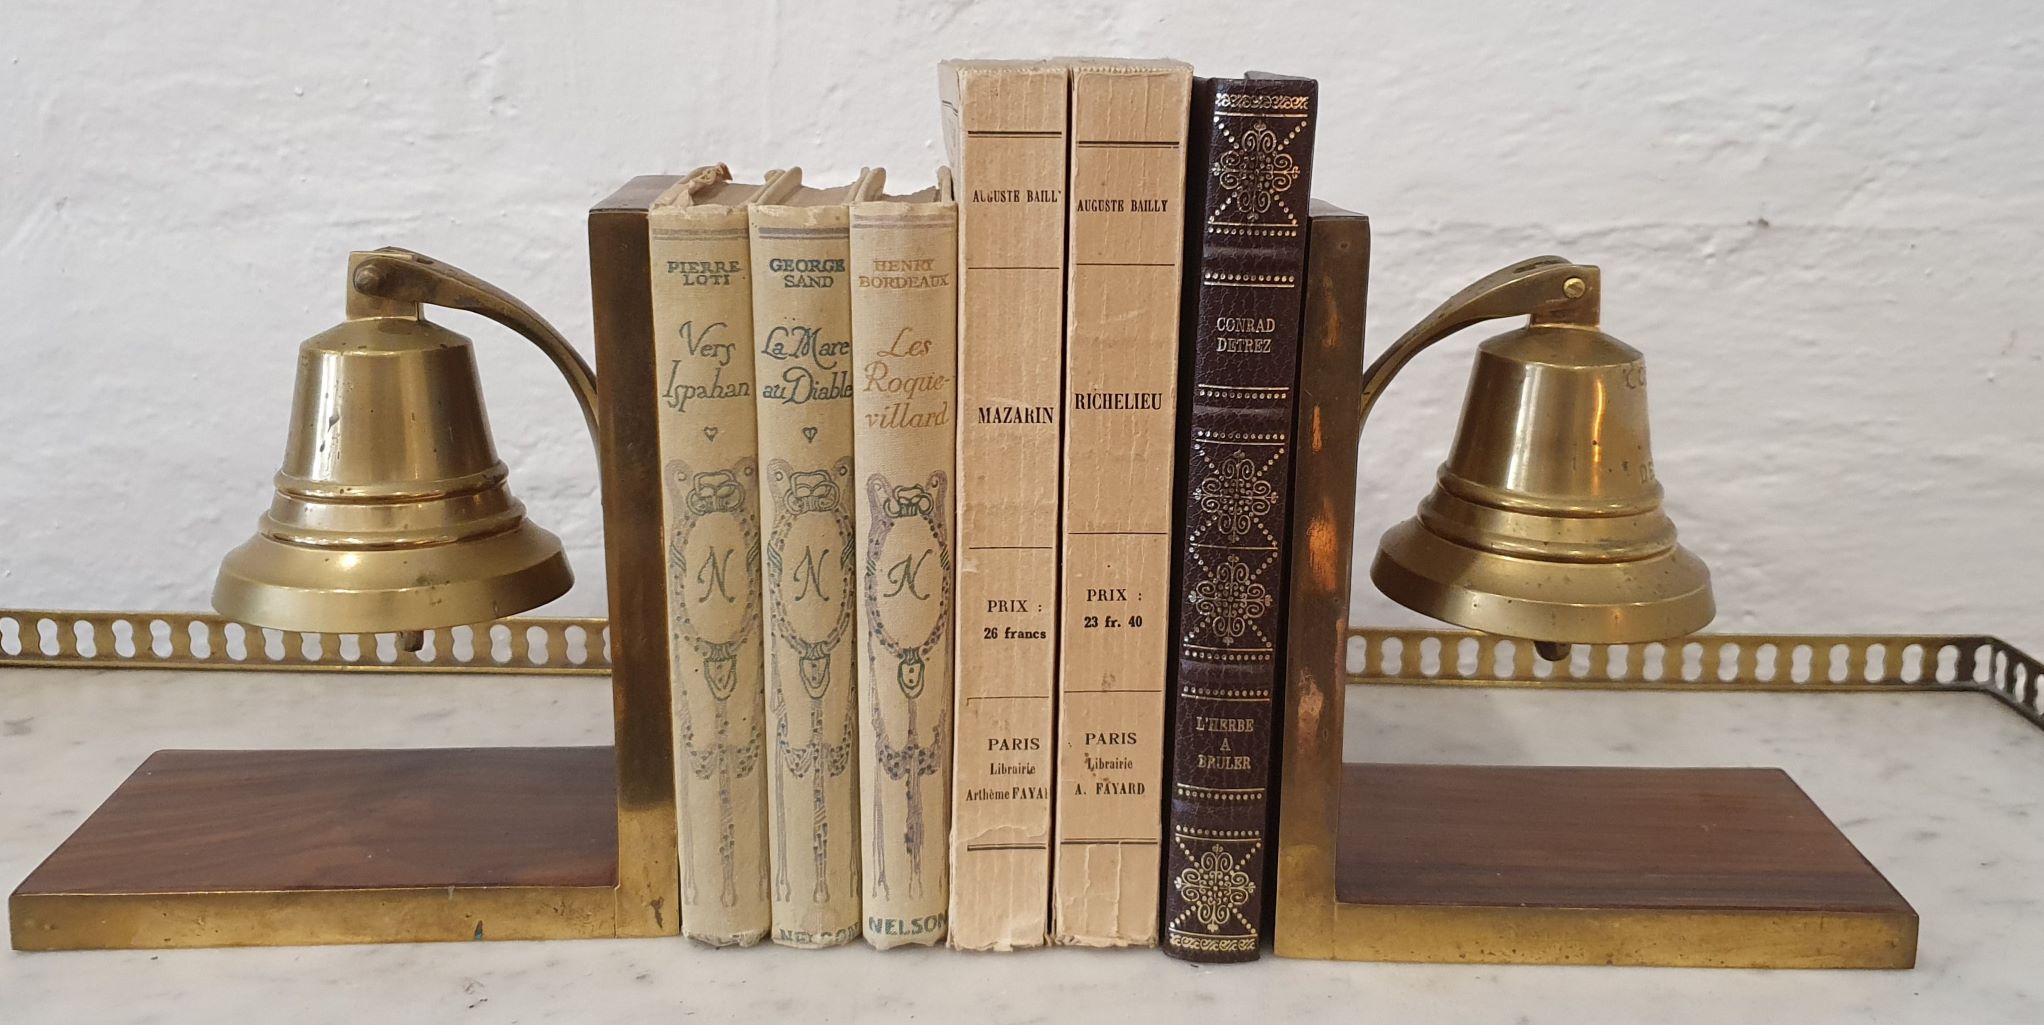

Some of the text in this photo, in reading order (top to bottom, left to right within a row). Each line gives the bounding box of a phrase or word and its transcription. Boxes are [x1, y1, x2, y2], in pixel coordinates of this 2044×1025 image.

[1027, 190, 1062, 203] BAILL
[1077, 200, 1168, 212] AUGUSTE BAILLY
[667, 260, 741, 274] PIERRE
[769, 258, 846, 273] GEORGE
[683, 274, 731, 286] LOTI
[784, 275, 835, 289] SAND
[858, 273, 950, 289] BORDEAUX
[1217, 317, 1275, 333] CONRAD
[679, 320, 736, 366] Vers
[761, 326, 850, 370] La Mare
[877, 327, 933, 358] Les
[1216, 337, 1272, 353] DETREZ
[662, 360, 751, 413] Ispahan
[763, 367, 853, 405] au Diable
[1075, 393, 1162, 410] RICHELIEU
[865, 402, 949, 430] villard
[978, 407, 1054, 424] MAZARIN
[697, 546, 735, 603] N
[793, 546, 830, 601] N
[883, 549, 933, 600] N
[1087, 589, 1127, 601] PRIX
[987, 600, 1028, 613] PRIX
[1084, 616, 1143, 628] 23 fr. 40
[984, 627, 1047, 640] 26 francs
[1196, 716, 1254, 732] L'HERBE
[988, 738, 1040, 751] PARIS
[1085, 732, 1137, 745] PARIS
[1220, 737, 1231, 751] A
[990, 763, 1036, 775] Librairie
[1087, 758, 1133, 770] Librairie
[1198, 754, 1251, 770] BRULER
[966, 788, 1010, 801] Arthème
[1075, 782, 1145, 796] A. FAYARD
[869, 911, 948, 935] NELSON
